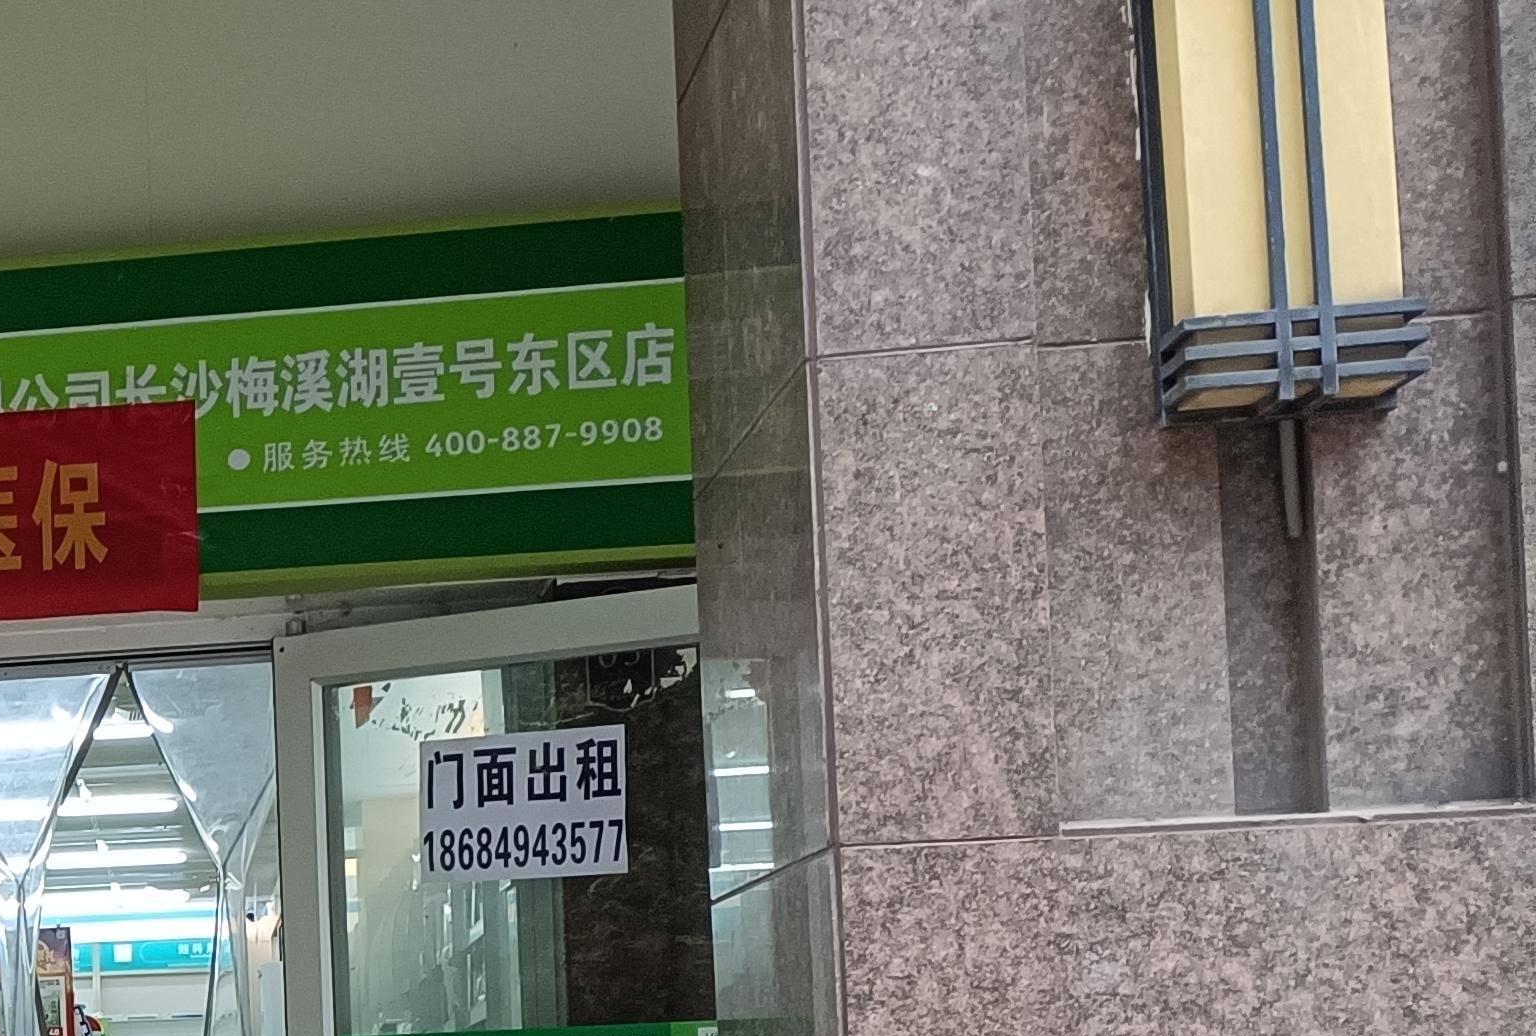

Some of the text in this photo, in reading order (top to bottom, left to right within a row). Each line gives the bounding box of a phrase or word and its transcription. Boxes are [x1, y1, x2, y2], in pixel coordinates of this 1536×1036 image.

[262, 416, 664, 473] 服务热线 400-887-9908
[427, 738, 622, 810] 门面出租
[423, 819, 624, 872] 18684943577
